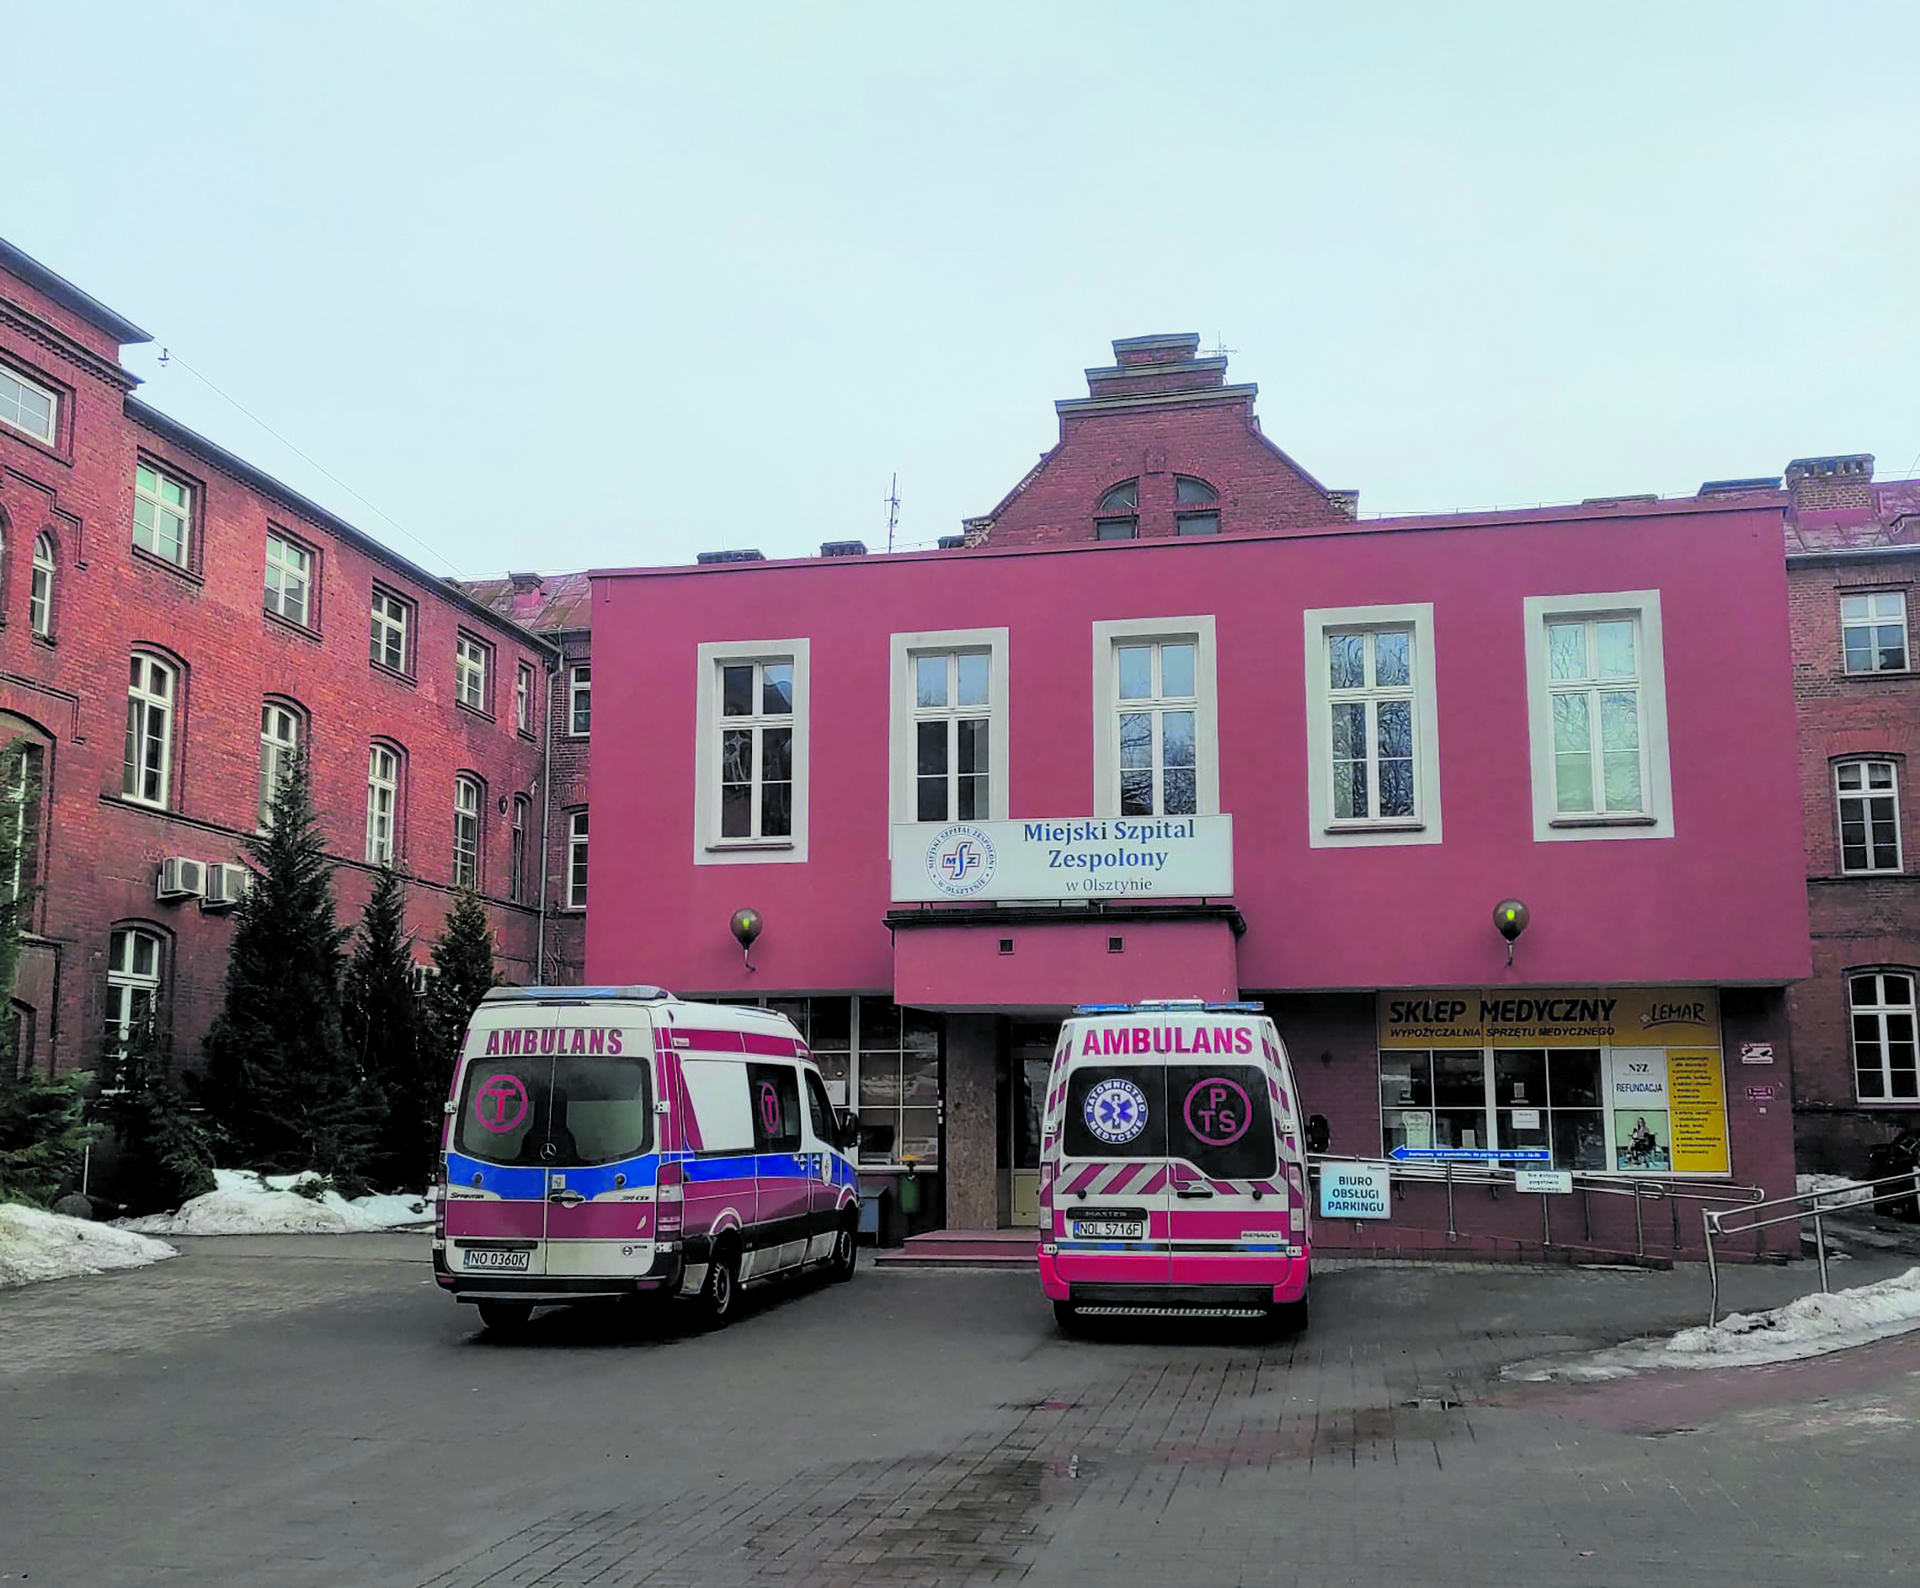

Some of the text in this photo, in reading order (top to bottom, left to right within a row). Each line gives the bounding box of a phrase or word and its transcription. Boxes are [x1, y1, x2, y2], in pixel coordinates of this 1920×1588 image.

[940, 826, 971, 839] SZPITAL
[1023, 819, 1195, 846] Miejski Szpital
[1048, 847, 1169, 873] Zespolony
[1065, 878, 1153, 894] w Olsztynie
[1389, 999, 1618, 1023] SKLEP MEDYCZNY
[1651, 1003, 1706, 1022] LEMAR
[486, 1029, 623, 1056] AMBULANS
[1082, 1027, 1254, 1056] AMBULANS
[1390, 1026, 1616, 1039] WYPOŻYCZALNIA SPRZĘTU MEDYCZNEGO
[1086, 1080, 1146, 1113] RATOWNICTWO
[1616, 1083, 1663, 1093] REFUNDACJA
[488, 1090, 515, 1122] T
[1210, 1088, 1227, 1110] P
[1089, 1119, 1143, 1142] MEDYCZNE
[1198, 1110, 1237, 1133] TS
[1338, 1176, 1373, 1187] BIURO
[1332, 1187, 1380, 1199] OBSŁUGI
[1327, 1201, 1385, 1213] PARKINGU
[1079, 1223, 1140, 1235] NOL 5716F
[472, 1252, 527, 1266] NO 0360K
